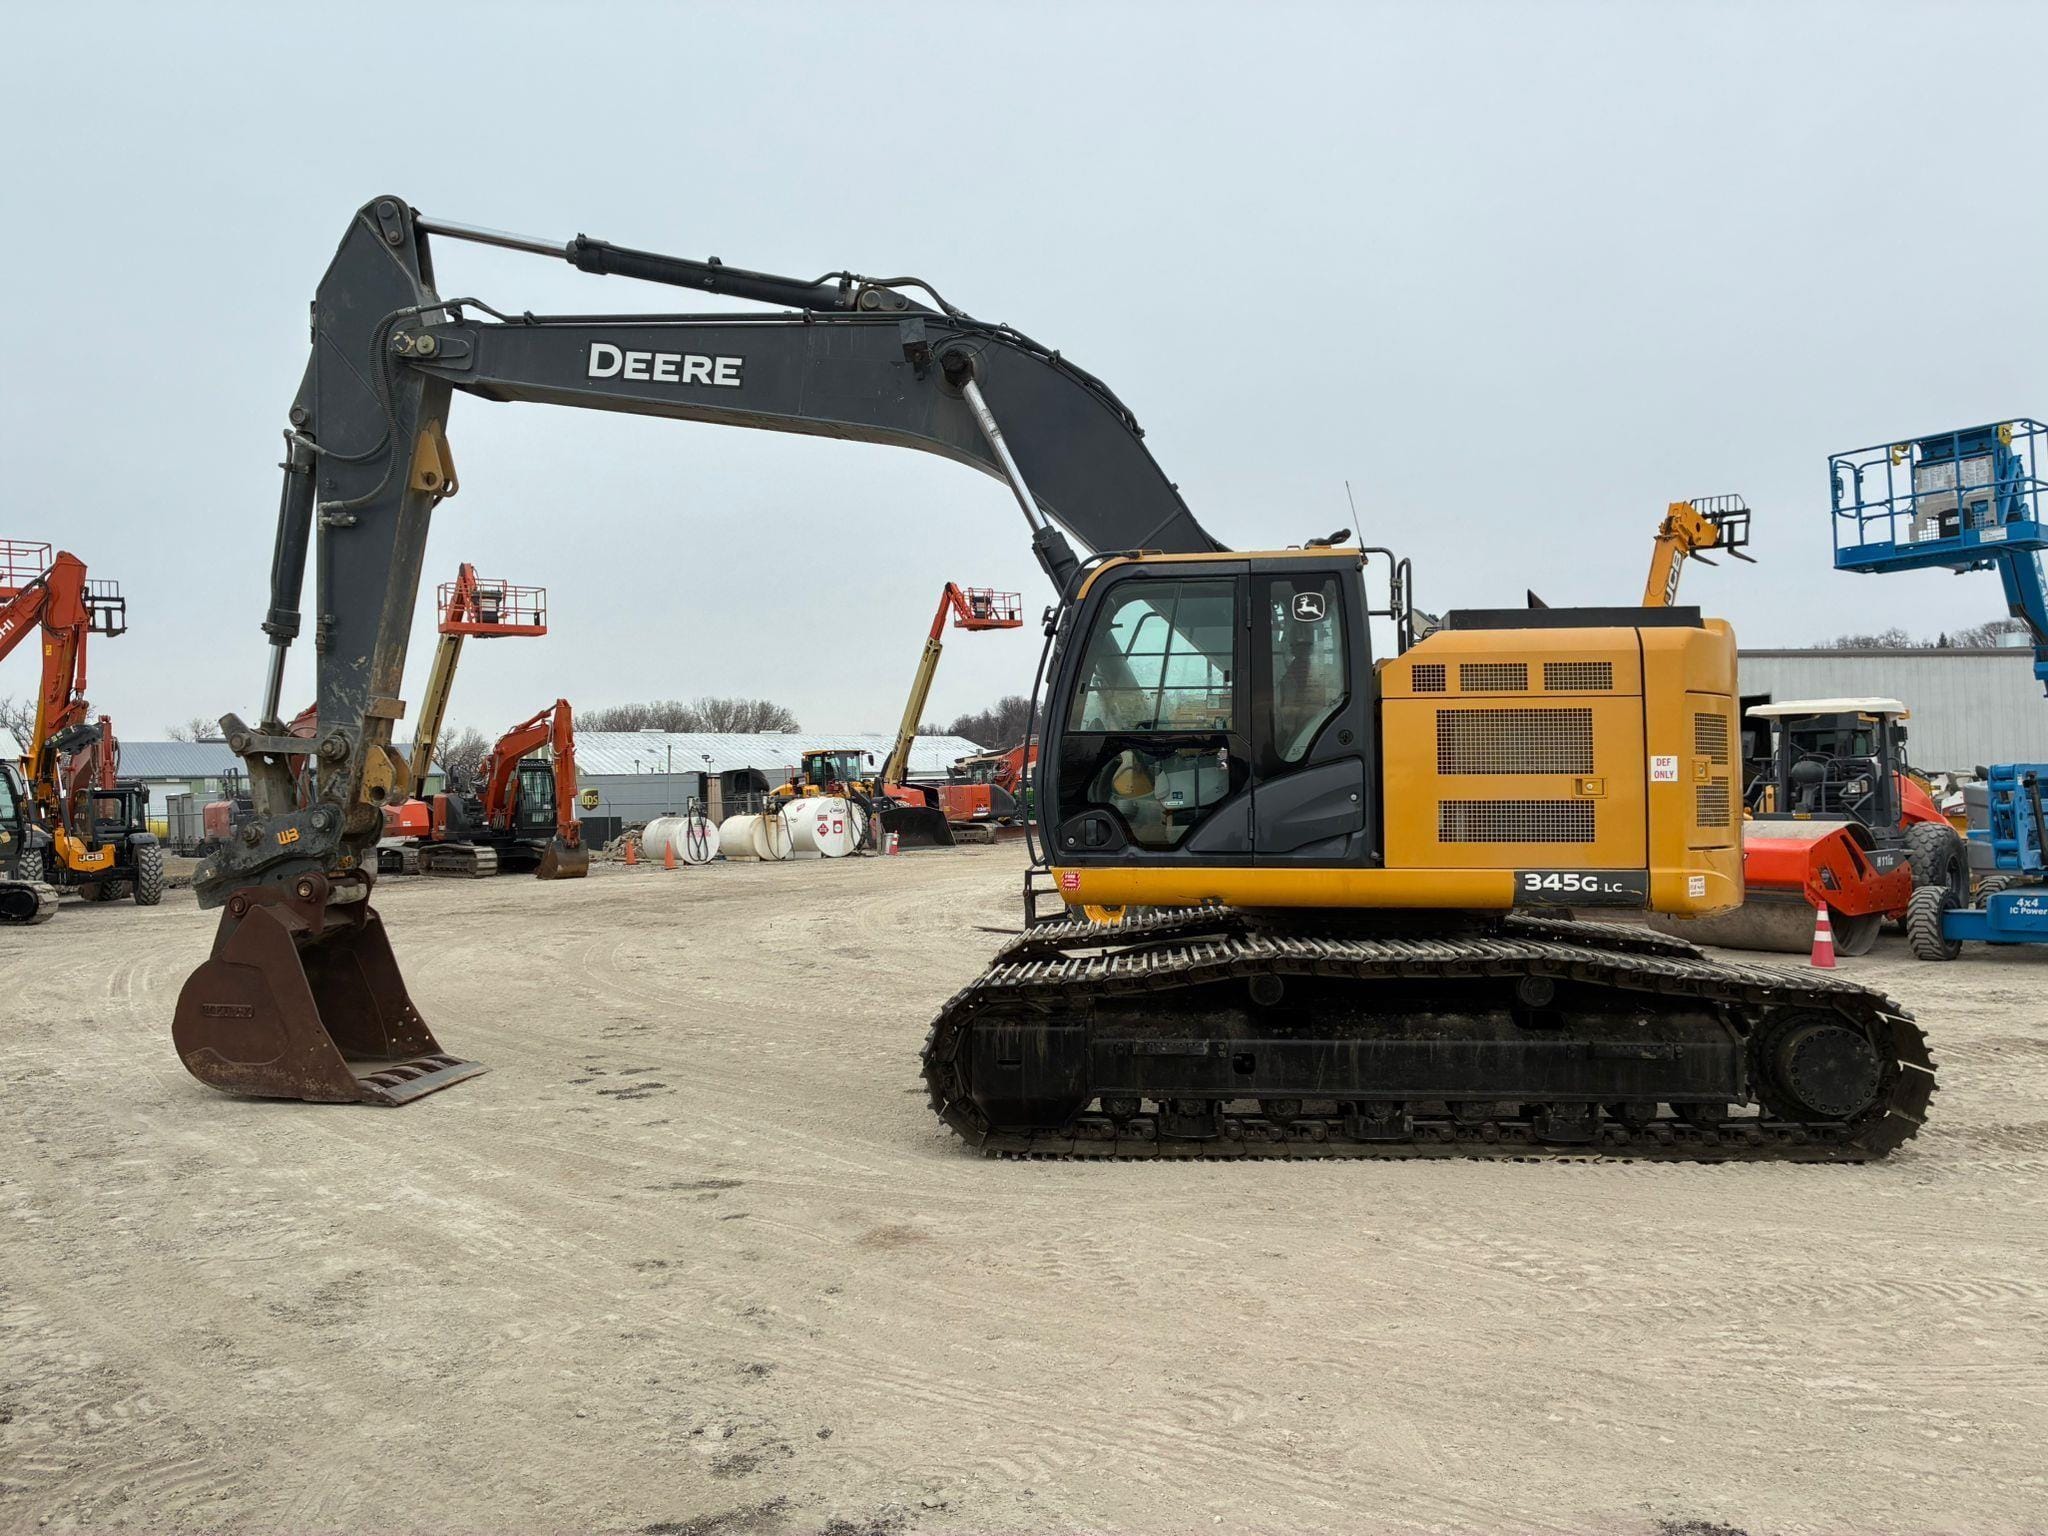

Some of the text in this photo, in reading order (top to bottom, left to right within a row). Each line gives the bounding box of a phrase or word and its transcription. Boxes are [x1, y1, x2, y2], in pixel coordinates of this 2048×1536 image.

[588, 343, 742, 386] DEERE
[1666, 551, 1681, 606] JCB
[1656, 758, 1671, 766] DEF
[1654, 770, 1674, 778] ONLY
[79, 854, 104, 862] JCB
[1524, 873, 1623, 893] 345G LC
[2016, 898, 2039, 907] 4x4
[2020, 907, 2047, 915] Power
